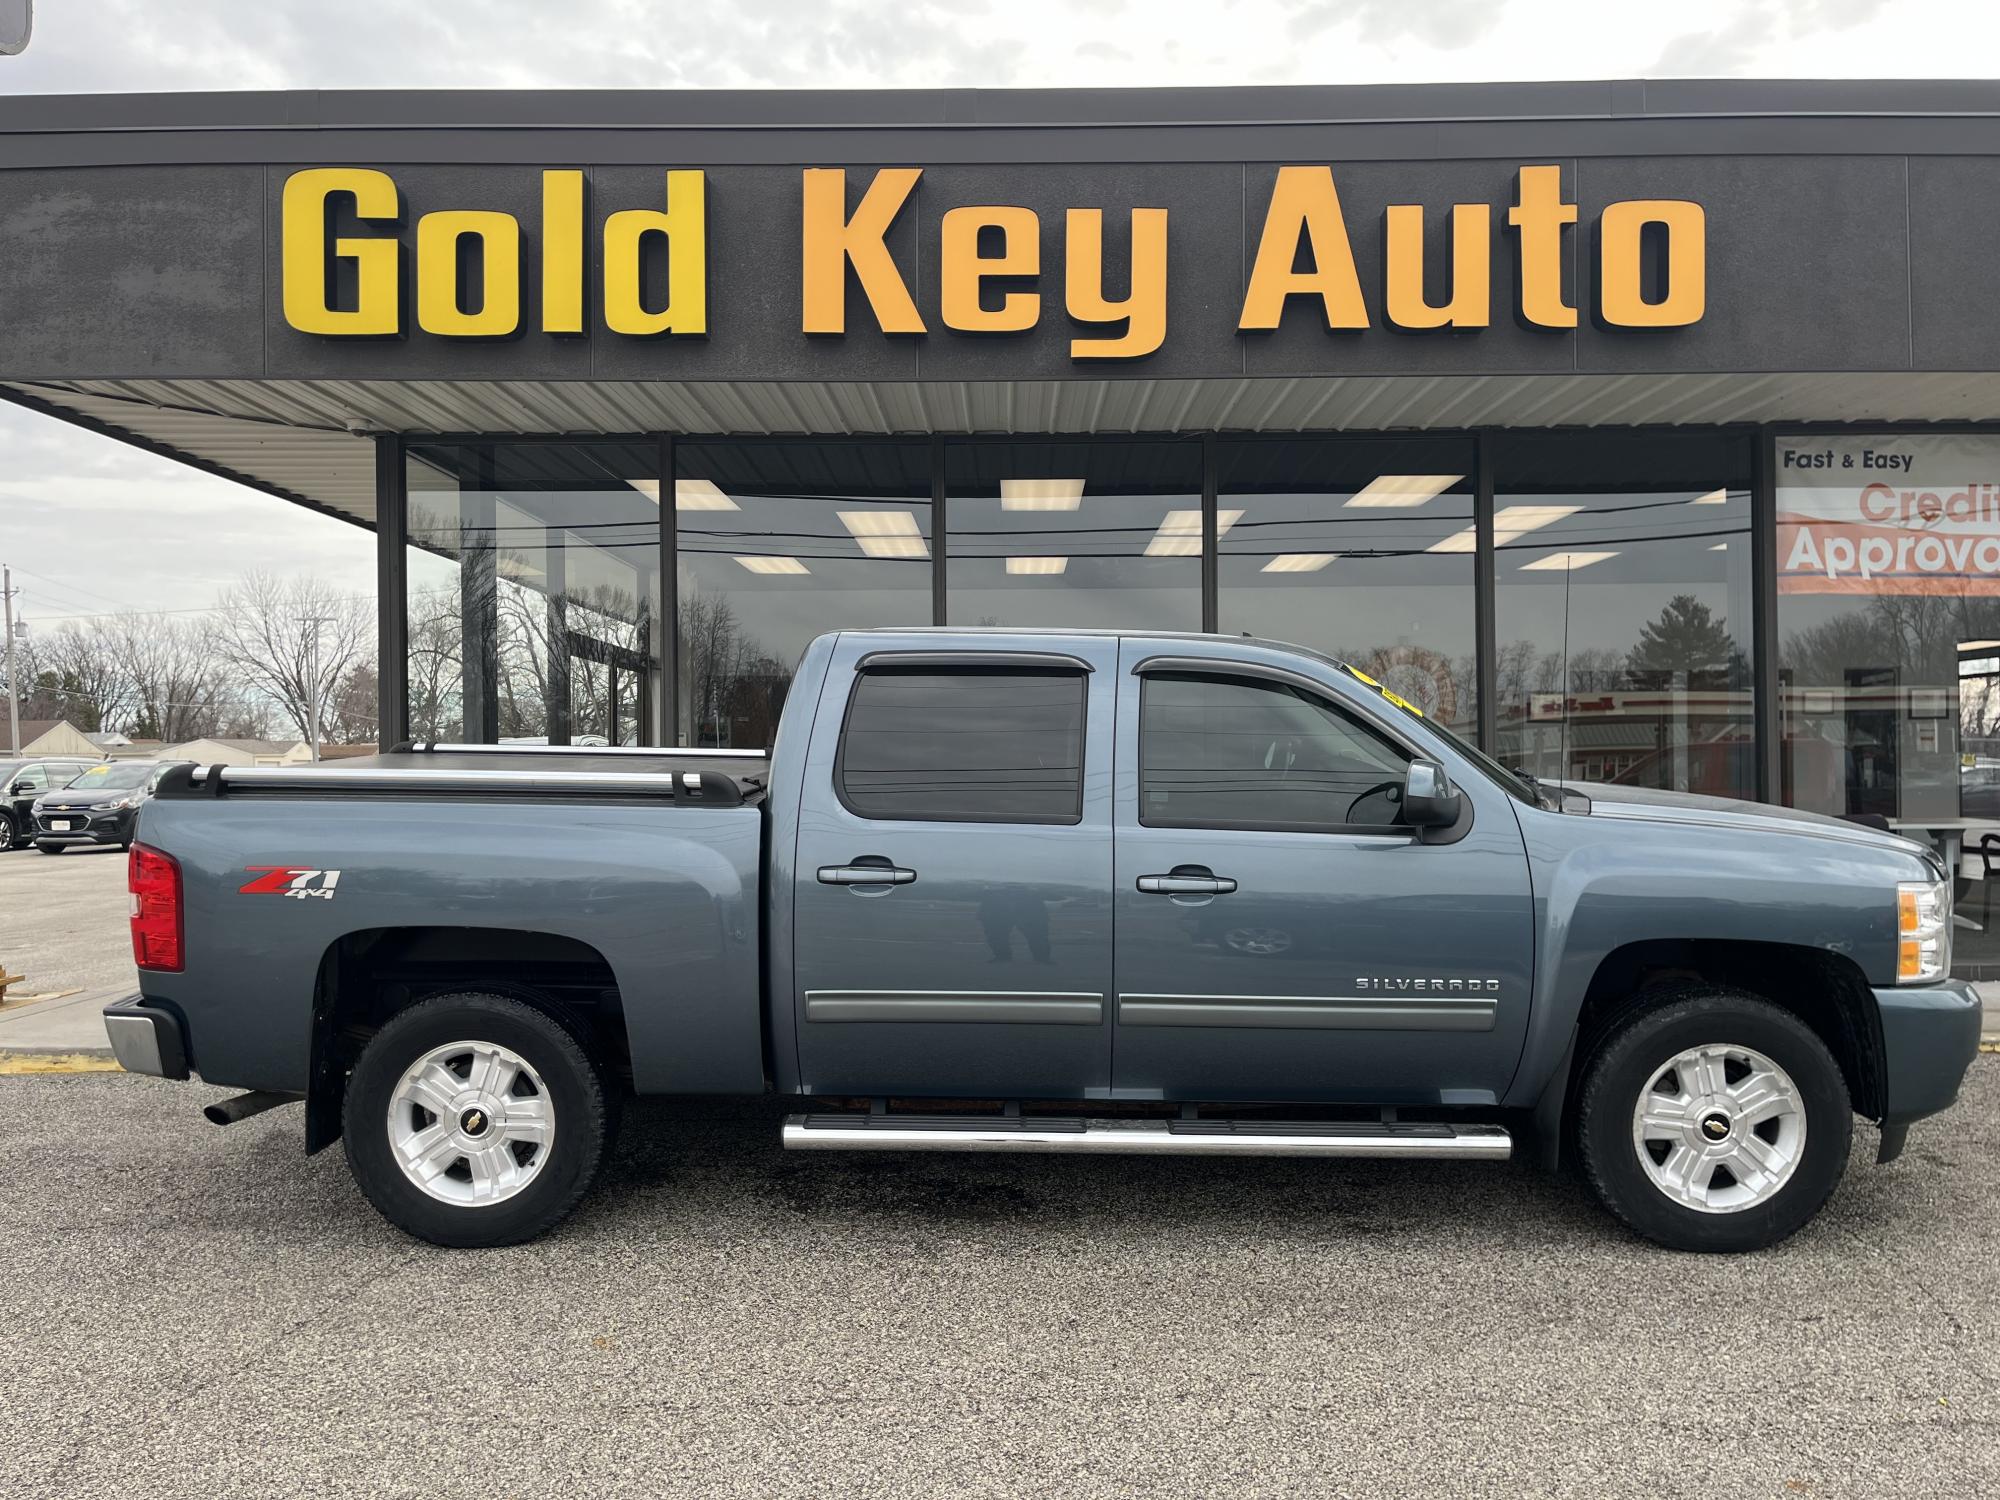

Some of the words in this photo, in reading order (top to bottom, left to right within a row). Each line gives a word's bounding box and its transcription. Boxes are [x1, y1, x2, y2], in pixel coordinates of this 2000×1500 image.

[281, 167, 706, 336] Gold
[802, 166, 1169, 358] Key
[1238, 165, 1706, 329] Auto
[1783, 450, 1834, 468] Fast
[1842, 454, 1854, 468] &
[1862, 450, 1914, 472] Easy
[238, 865, 341, 895] Z71
[1355, 978, 1500, 991] SILVERADO
